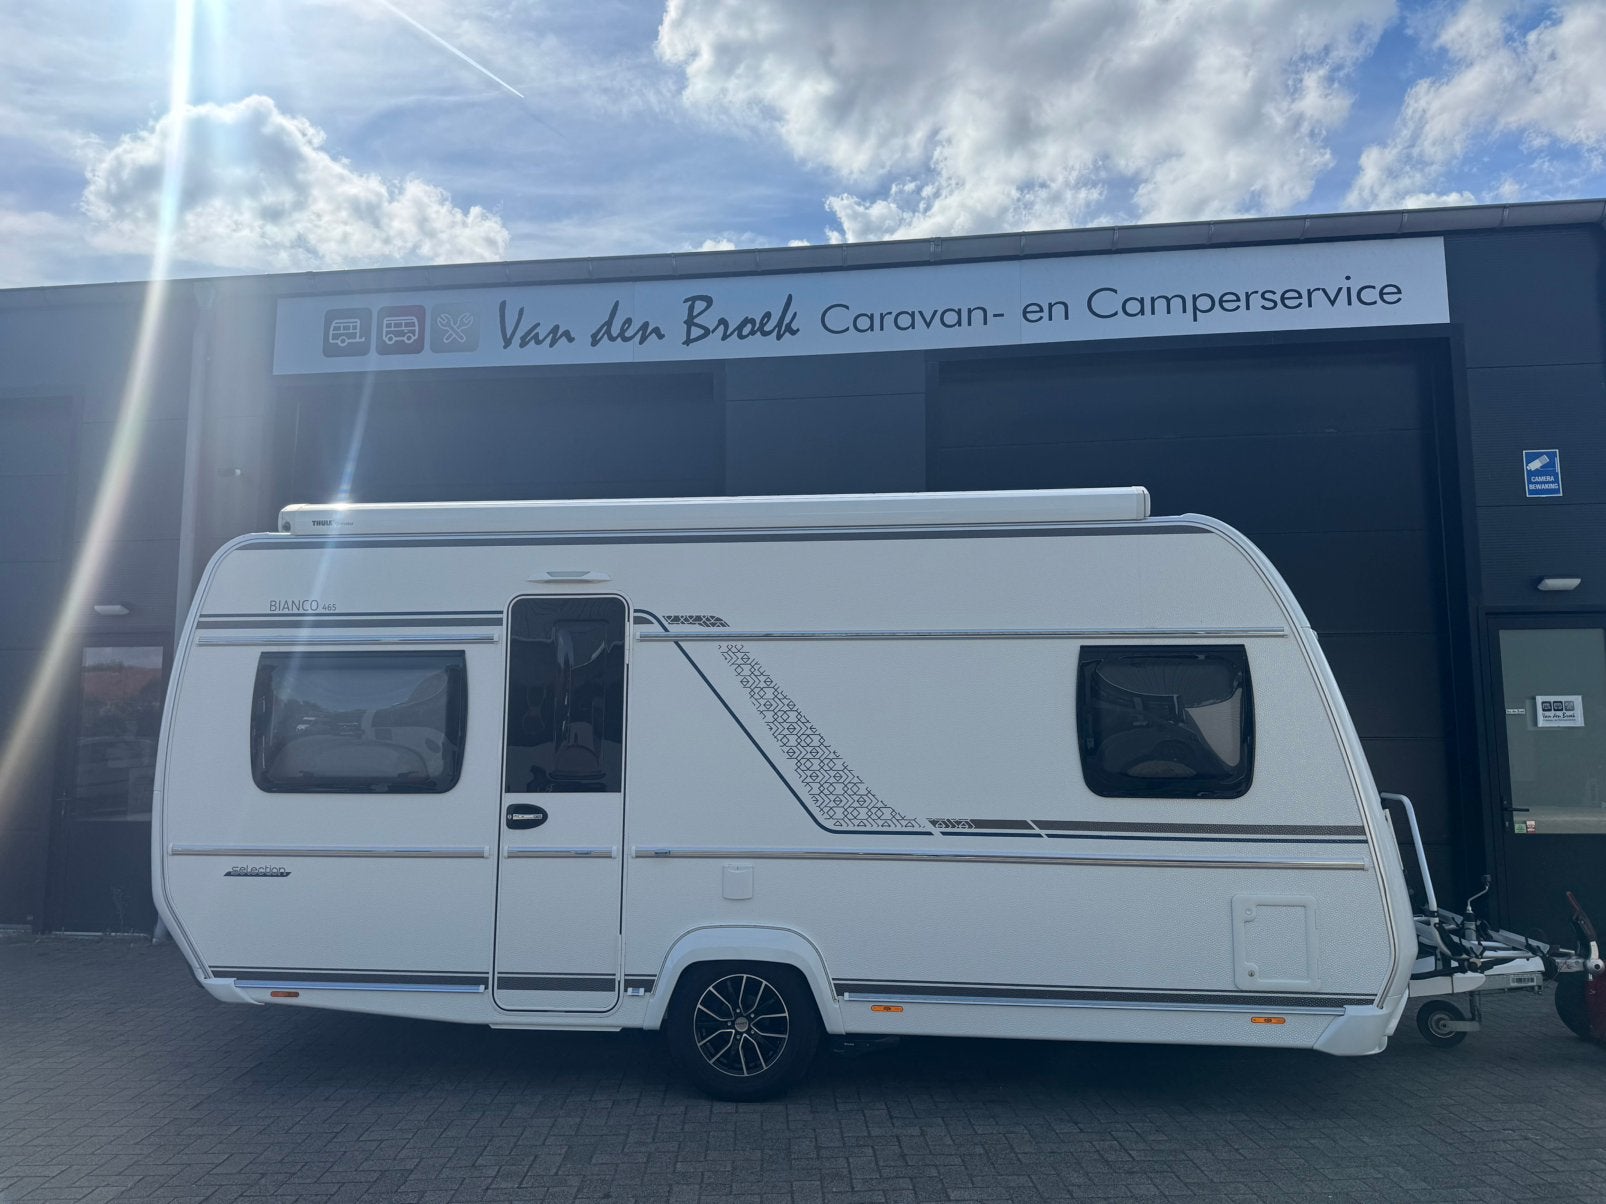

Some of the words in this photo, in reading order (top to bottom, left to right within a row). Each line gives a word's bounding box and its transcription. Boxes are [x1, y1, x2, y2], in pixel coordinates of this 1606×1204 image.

[498, 299, 576, 350] Van
[590, 299, 666, 348] den
[681, 293, 800, 347] Broek
[820, 303, 1005, 335] Caravan-
[1021, 300, 1070, 325] en
[1086, 275, 1403, 322] Camperservice
[269, 599, 319, 612] BIANCO
[322, 603, 336, 611] 465
[231, 865, 286, 876] selection
